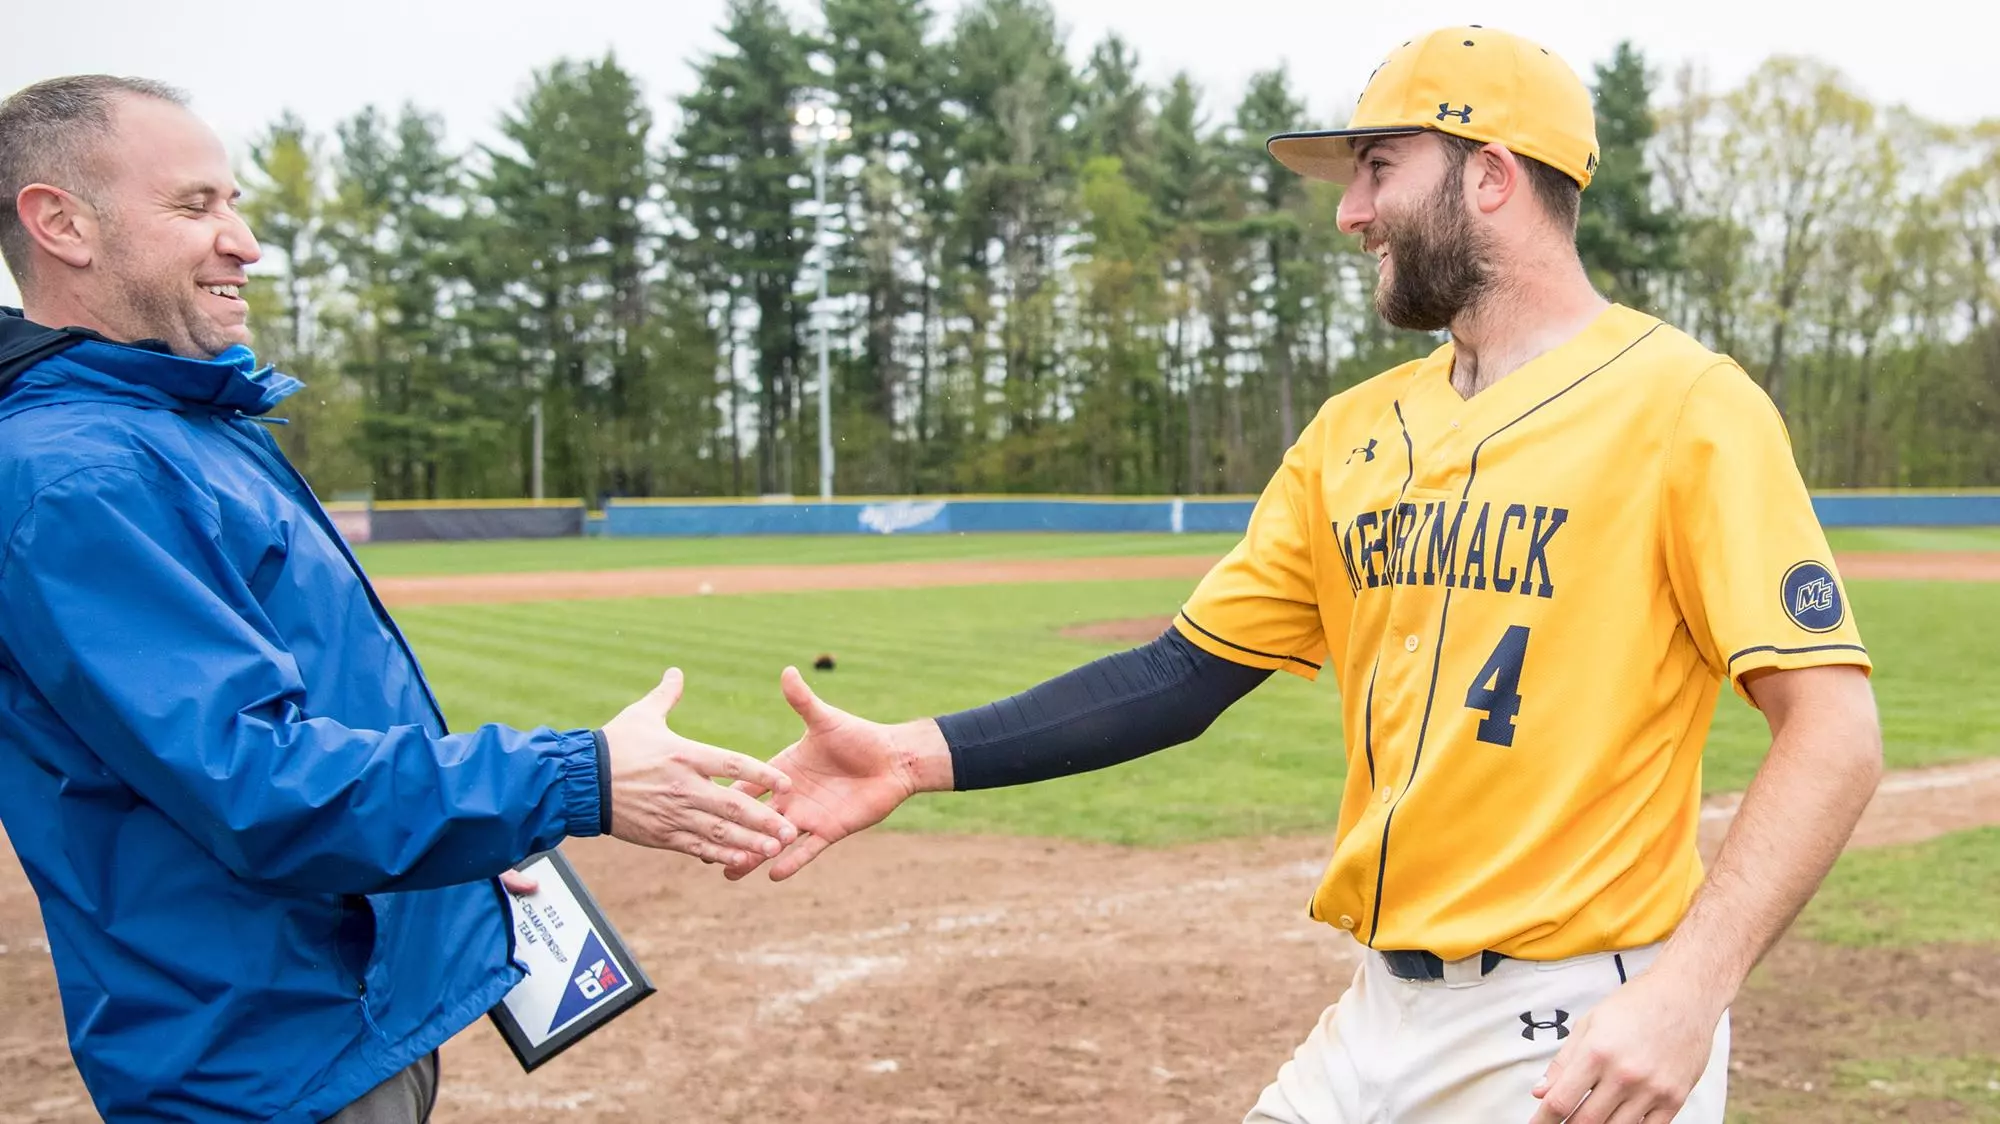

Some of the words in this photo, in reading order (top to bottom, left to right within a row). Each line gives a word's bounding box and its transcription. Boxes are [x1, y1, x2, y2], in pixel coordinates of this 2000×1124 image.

[1795, 577, 1834, 616] MC
[1464, 625, 1531, 747] 4
[517, 920, 538, 945] TEAM
[543, 904, 564, 929] 2018
